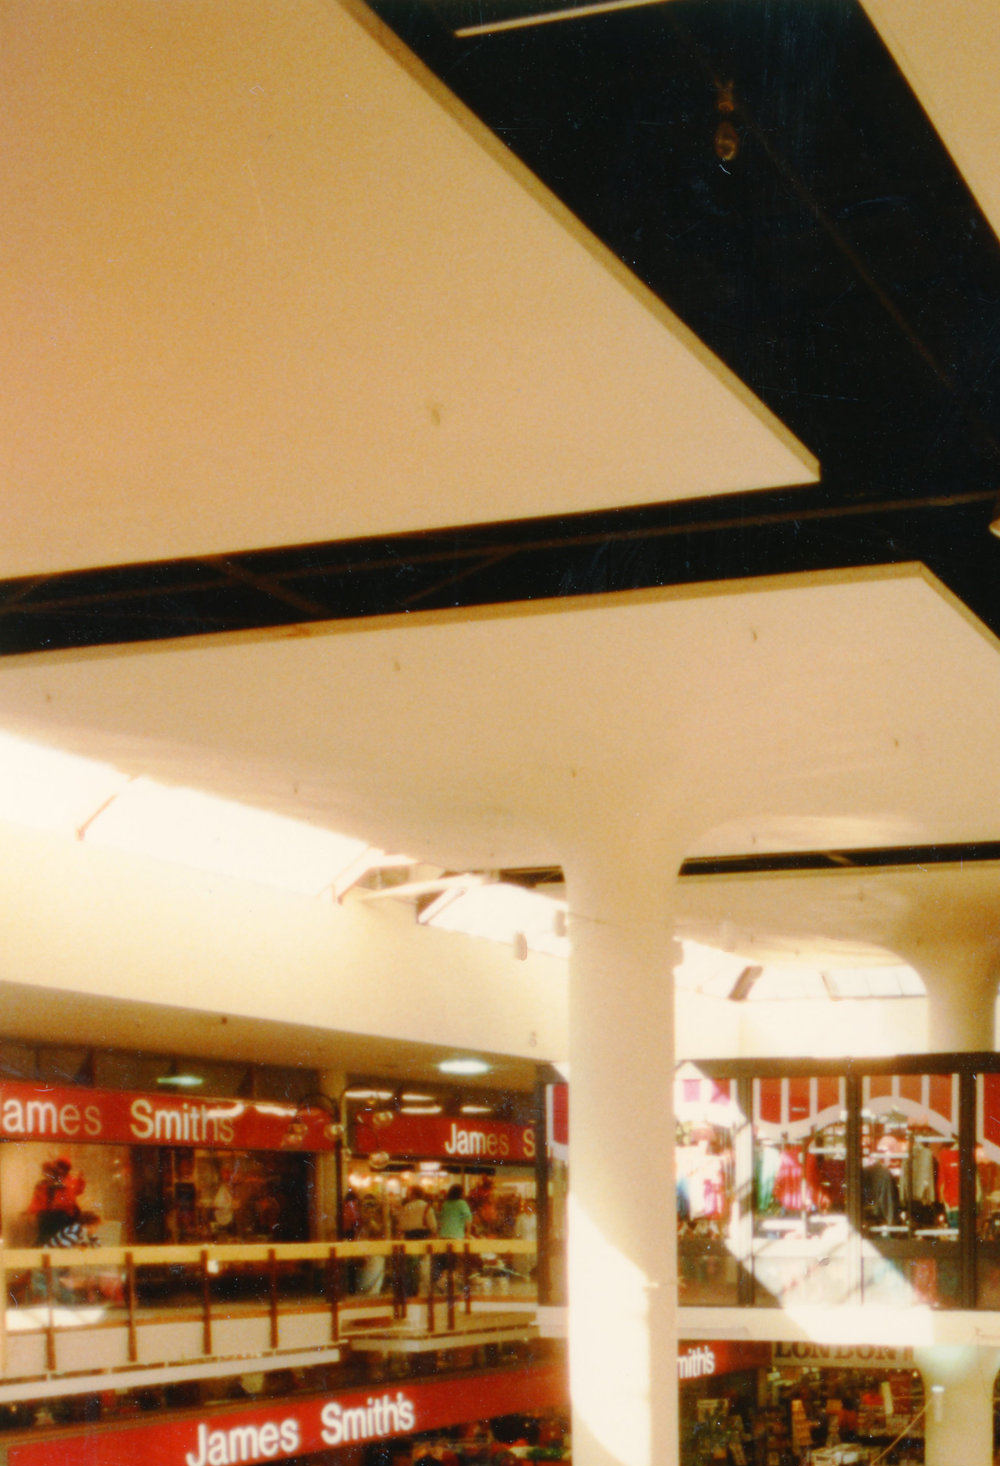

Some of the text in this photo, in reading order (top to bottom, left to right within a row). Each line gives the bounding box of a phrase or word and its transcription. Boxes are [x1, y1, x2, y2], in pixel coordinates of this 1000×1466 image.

[444, 1123, 509, 1156] James
[773, 1341, 898, 1361] LONDON
[320, 1391, 415, 1445] Smith's
